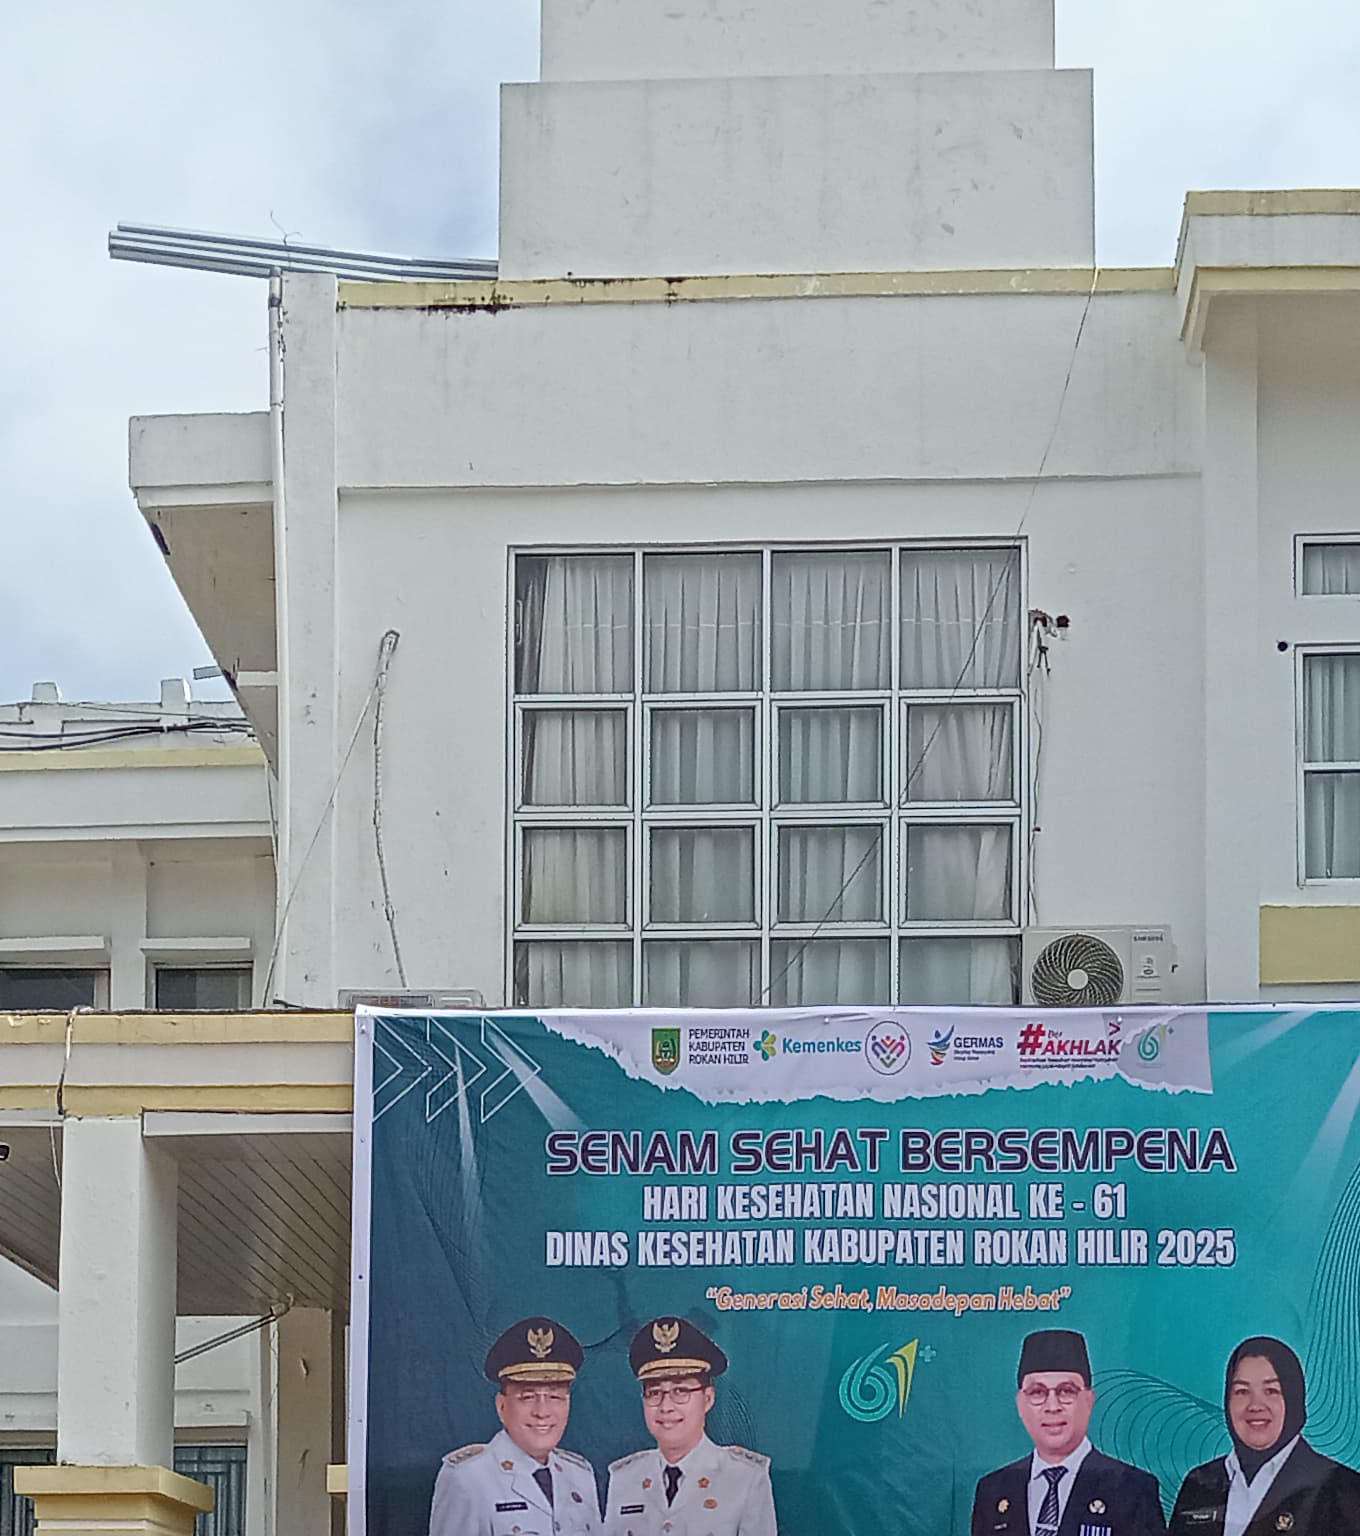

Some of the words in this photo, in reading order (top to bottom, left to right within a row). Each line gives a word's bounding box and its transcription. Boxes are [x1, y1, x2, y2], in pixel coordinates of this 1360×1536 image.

[689, 1028, 750, 1039] PEMERINTAH
[953, 1036, 1004, 1048] GERMAS
[689, 1041, 745, 1051] KABUPATEN
[782, 1037, 862, 1054] Kemenkes
[689, 1054, 721, 1064] ROKAN
[546, 1130, 718, 1175] SENAM
[731, 1129, 888, 1173] SEHAT
[900, 1128, 1237, 1173] BERSEMPENA
[643, 1185, 707, 1220] HARI
[717, 1183, 874, 1220] KESEHATAN
[883, 1183, 1020, 1219] NASIONAL
[1029, 1183, 1064, 1219] KE
[1094, 1183, 1127, 1219] 61
[546, 1231, 629, 1266] DINAS
[638, 1229, 795, 1266] KESEHATAN
[804, 1229, 964, 1265] KABUPATEN
[974, 1229, 1067, 1265] ROKAN
[1077, 1229, 1149, 1265] HILIR
[1157, 1229, 1236, 1266] 2025
[809, 1286, 873, 1313] Sehat,
